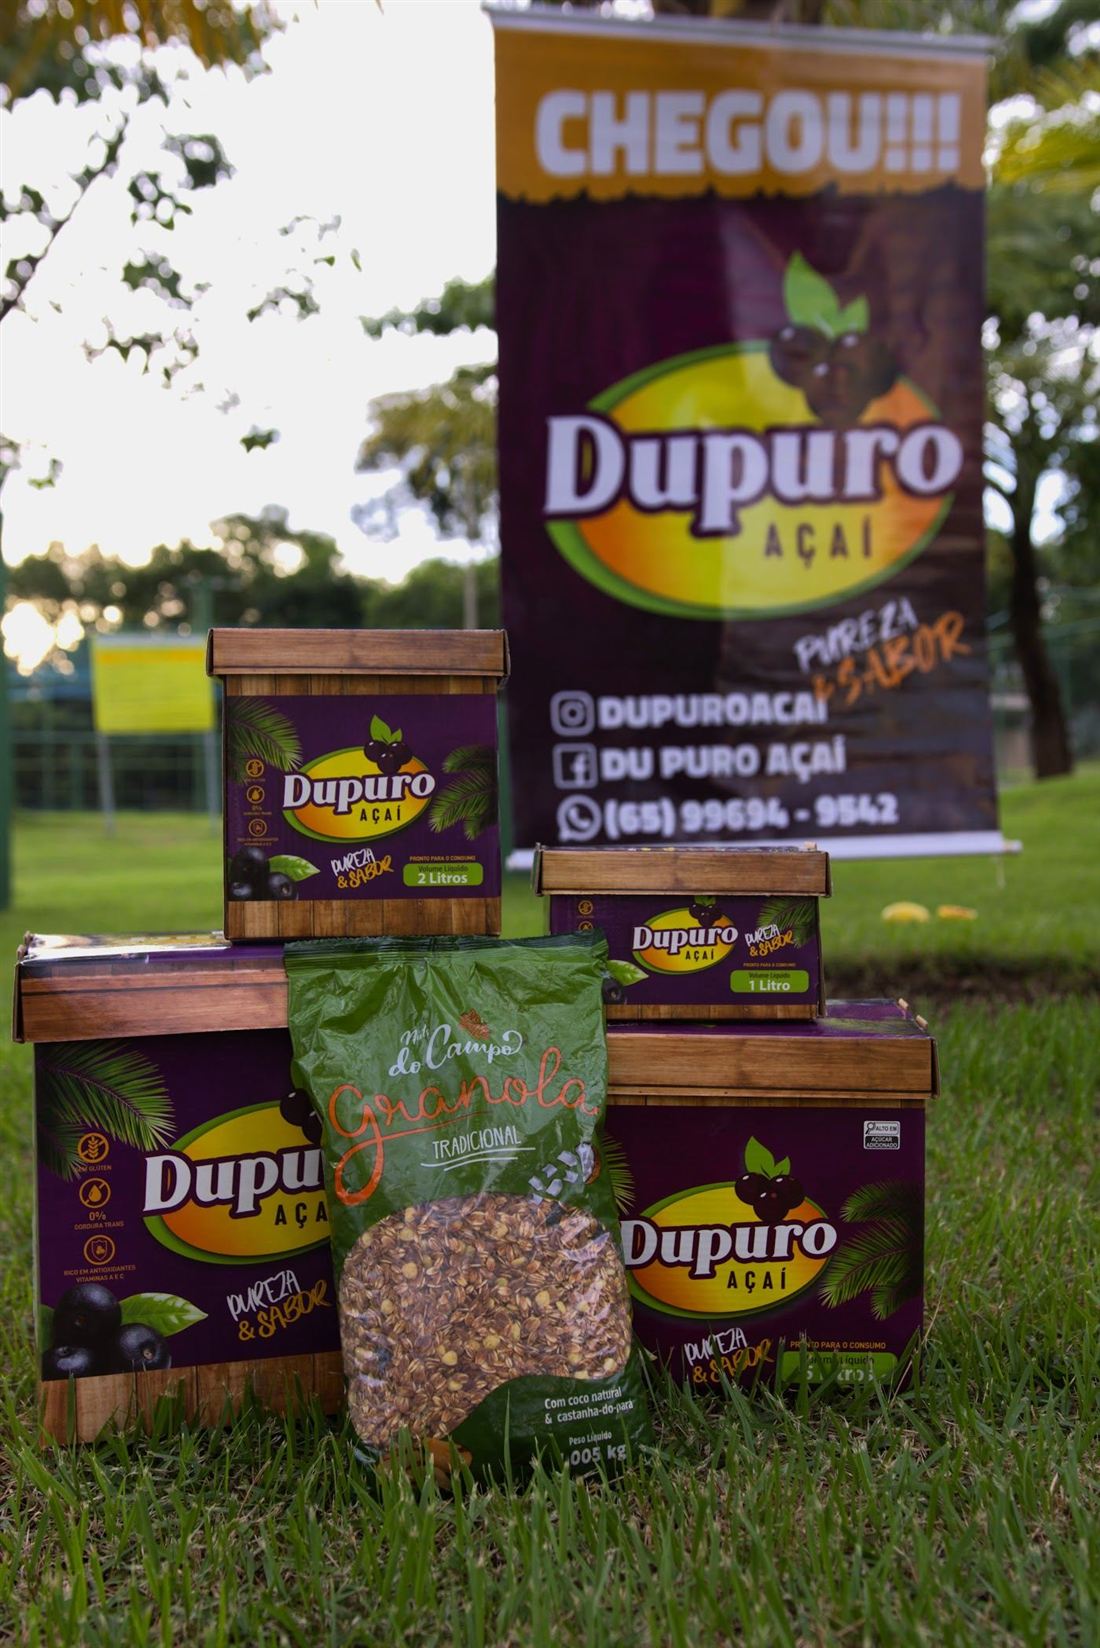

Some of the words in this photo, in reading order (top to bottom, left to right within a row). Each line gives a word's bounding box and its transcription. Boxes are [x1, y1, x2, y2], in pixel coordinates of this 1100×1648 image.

[536, 89, 961, 177] CHEGOU!!!
[544, 416, 963, 532] Dupuro
[764, 514, 873, 567] AÇAÍ
[794, 597, 919, 674] PUREZA
[837, 611, 972, 705] SABOR
[601, 748, 654, 782] DU
[660, 744, 760, 779] PURO
[766, 735, 847, 784] AÇAÍ
[283, 773, 436, 813] Dupuro
[359, 804, 401, 825] AÇAÍ
[604, 797, 676, 839] (65)
[681, 799, 790, 833] 99694
[815, 793, 898, 827] 9542
[330, 848, 376, 876] PUREZA
[337, 875, 348, 889] &
[349, 854, 394, 889] SABOR
[418, 865, 443, 873] Volume
[417, 873, 426, 884] 2
[429, 872, 468, 884] Litros
[632, 925, 739, 953] Dupuro
[744, 923, 780, 947] PUREZA
[759, 930, 794, 957] SABOR
[685, 949, 715, 963] AÇAÍ
[749, 980, 755, 991] 1
[759, 979, 791, 991] Litro
[388, 1047, 421, 1076] do
[426, 1024, 522, 1070] Campo
[432, 1125, 522, 1159] TRADICIONAL
[143, 1148, 321, 1214] Dupu
[89, 1211, 106, 1221] 0%
[274, 1201, 328, 1229] AÇA
[620, 1220, 837, 1275] Dupuro
[727, 1267, 786, 1293] AÇAÍ
[226, 1269, 301, 1322] PUREZA
[239, 1321, 256, 1341] &
[256, 1279, 333, 1338] SABOR
[821, 1341, 841, 1349] PARA
[849, 1341, 887, 1350] CONSUMO
[544, 1398, 566, 1409] Com
[568, 1394, 589, 1406] coco
[591, 1386, 622, 1402] natural
[544, 1413, 553, 1424] &
[569, 1436, 585, 1446] Peso
[607, 1444, 626, 1461] kg
